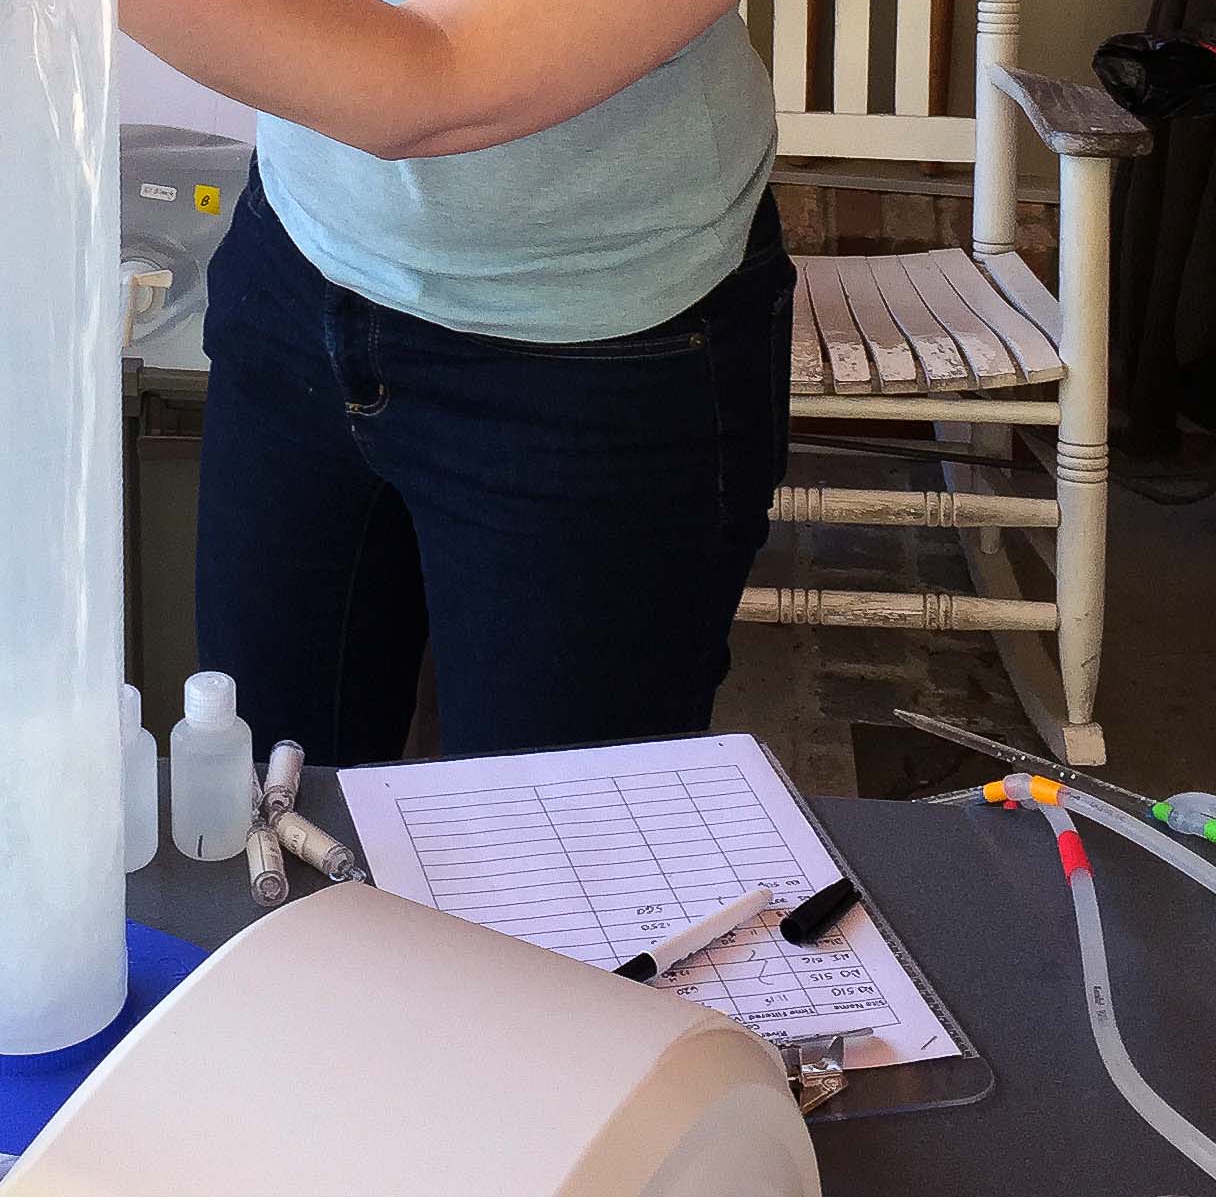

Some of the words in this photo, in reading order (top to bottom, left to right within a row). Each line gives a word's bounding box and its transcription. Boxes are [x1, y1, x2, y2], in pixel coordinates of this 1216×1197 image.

[833, 1002, 865, 1011] Name
[748, 1011, 788, 1022] Filtered
[790, 1007, 816, 1017] Time
